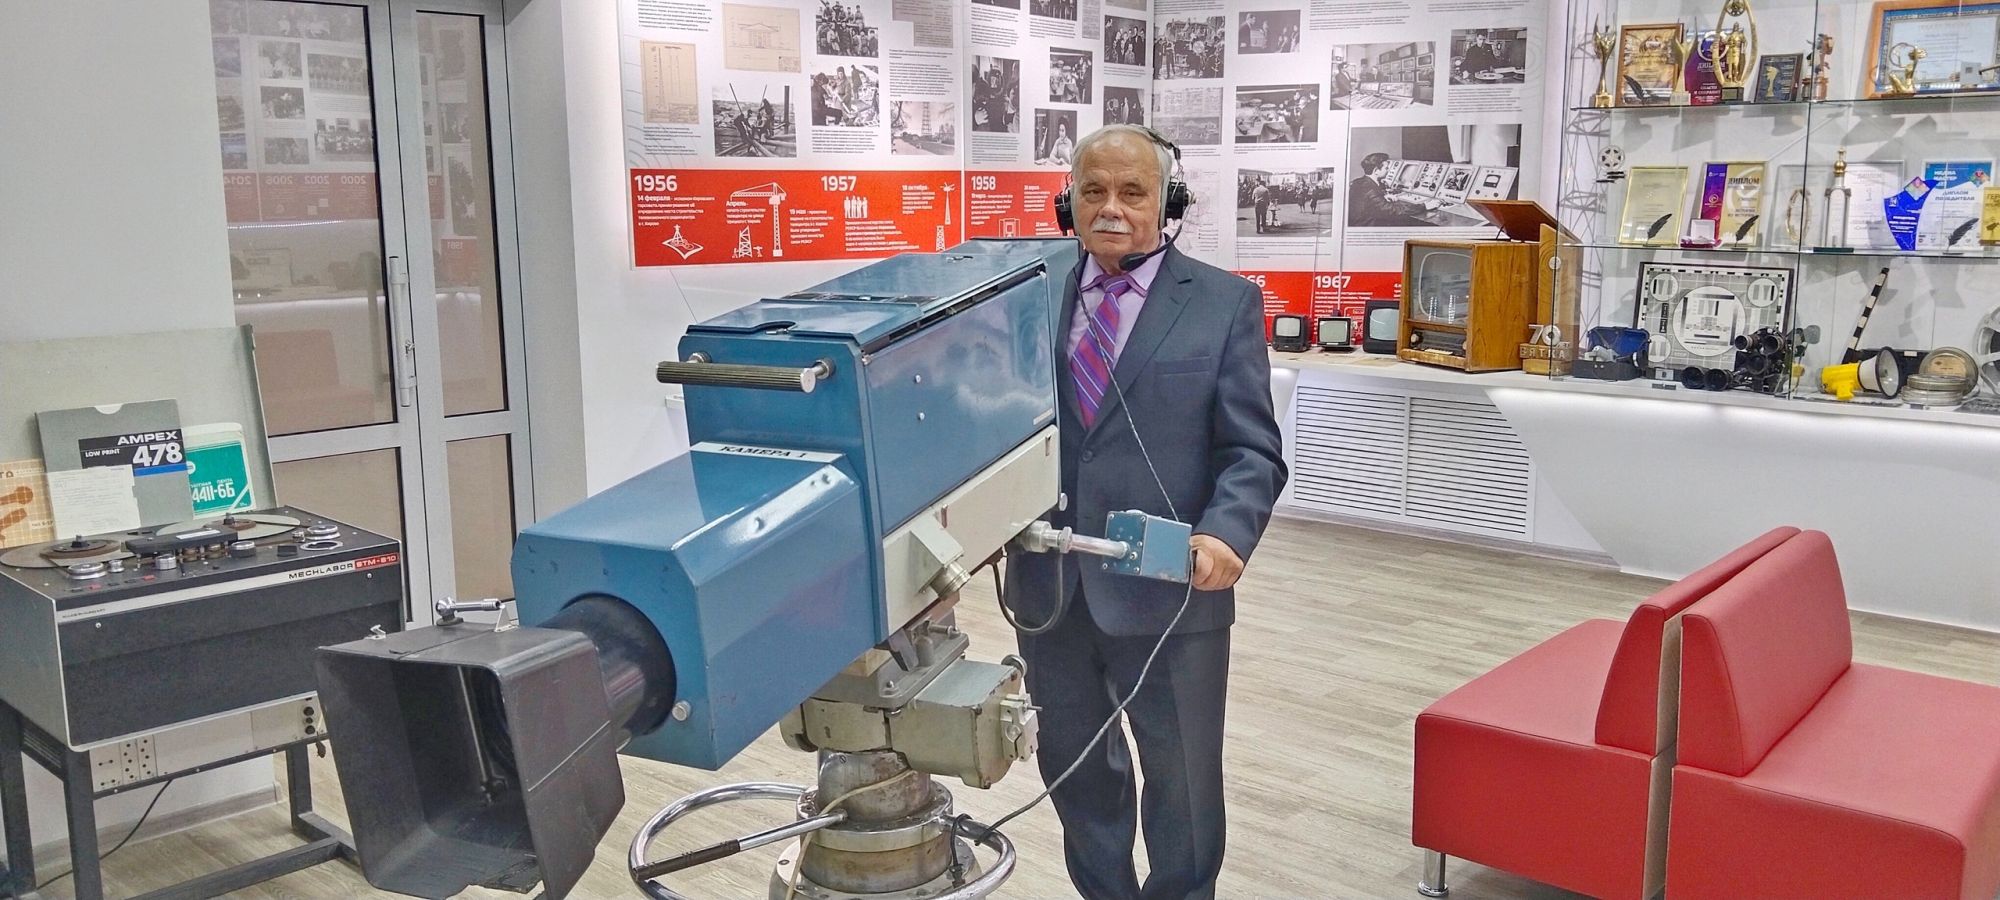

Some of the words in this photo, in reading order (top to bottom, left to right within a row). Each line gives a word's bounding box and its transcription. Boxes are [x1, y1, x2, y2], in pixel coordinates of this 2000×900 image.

[634, 175, 678, 192] 1956
[820, 175, 857, 192] 1957
[971, 175, 996, 190] 1958
[1728, 177, 1760, 185] ДИПЛОМ
[1315, 275, 1351, 288] 1967
[1528, 324, 1561, 346] 70
[1520, 346, 1567, 359] ВЯТКА
[117, 431, 178, 446] AMPEX
[85, 450, 101, 458] LOW
[101, 448, 120, 456] PRINT
[132, 442, 183, 468] 478
[720, 446, 791, 457] КАМЕРА
[288, 562, 354, 580] MECHLABOR
